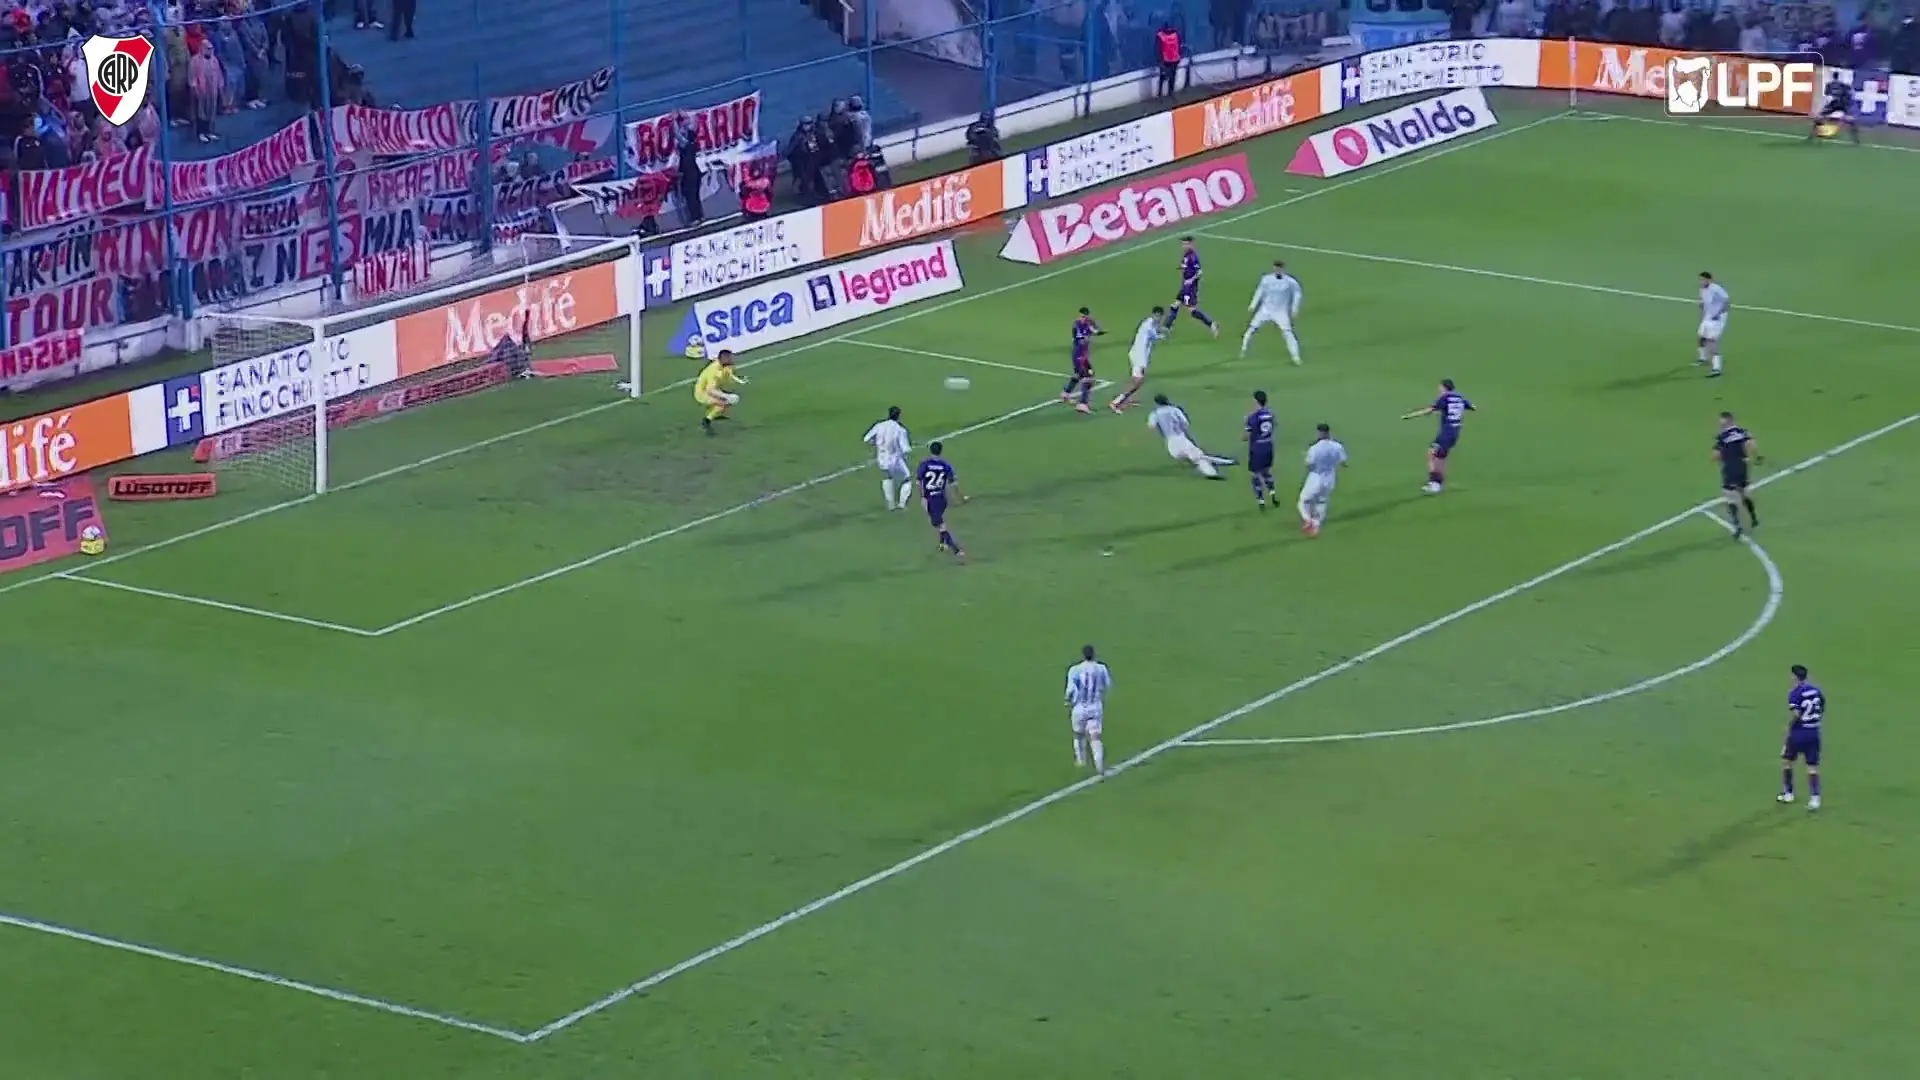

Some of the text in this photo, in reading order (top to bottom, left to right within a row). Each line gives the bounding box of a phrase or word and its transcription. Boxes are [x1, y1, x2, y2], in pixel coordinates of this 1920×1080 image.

[637, 97, 757, 167] ROARIO
[1367, 100, 1477, 154] Naldo
[22, 145, 147, 228] MATHEU
[858, 172, 973, 247] Medifé
[1041, 168, 1247, 256] Betano
[7, 276, 115, 346] TOUR
[705, 245, 948, 343] sica legrand
[1260, 421, 1273, 439] 9
[925, 471, 945, 490] 26
